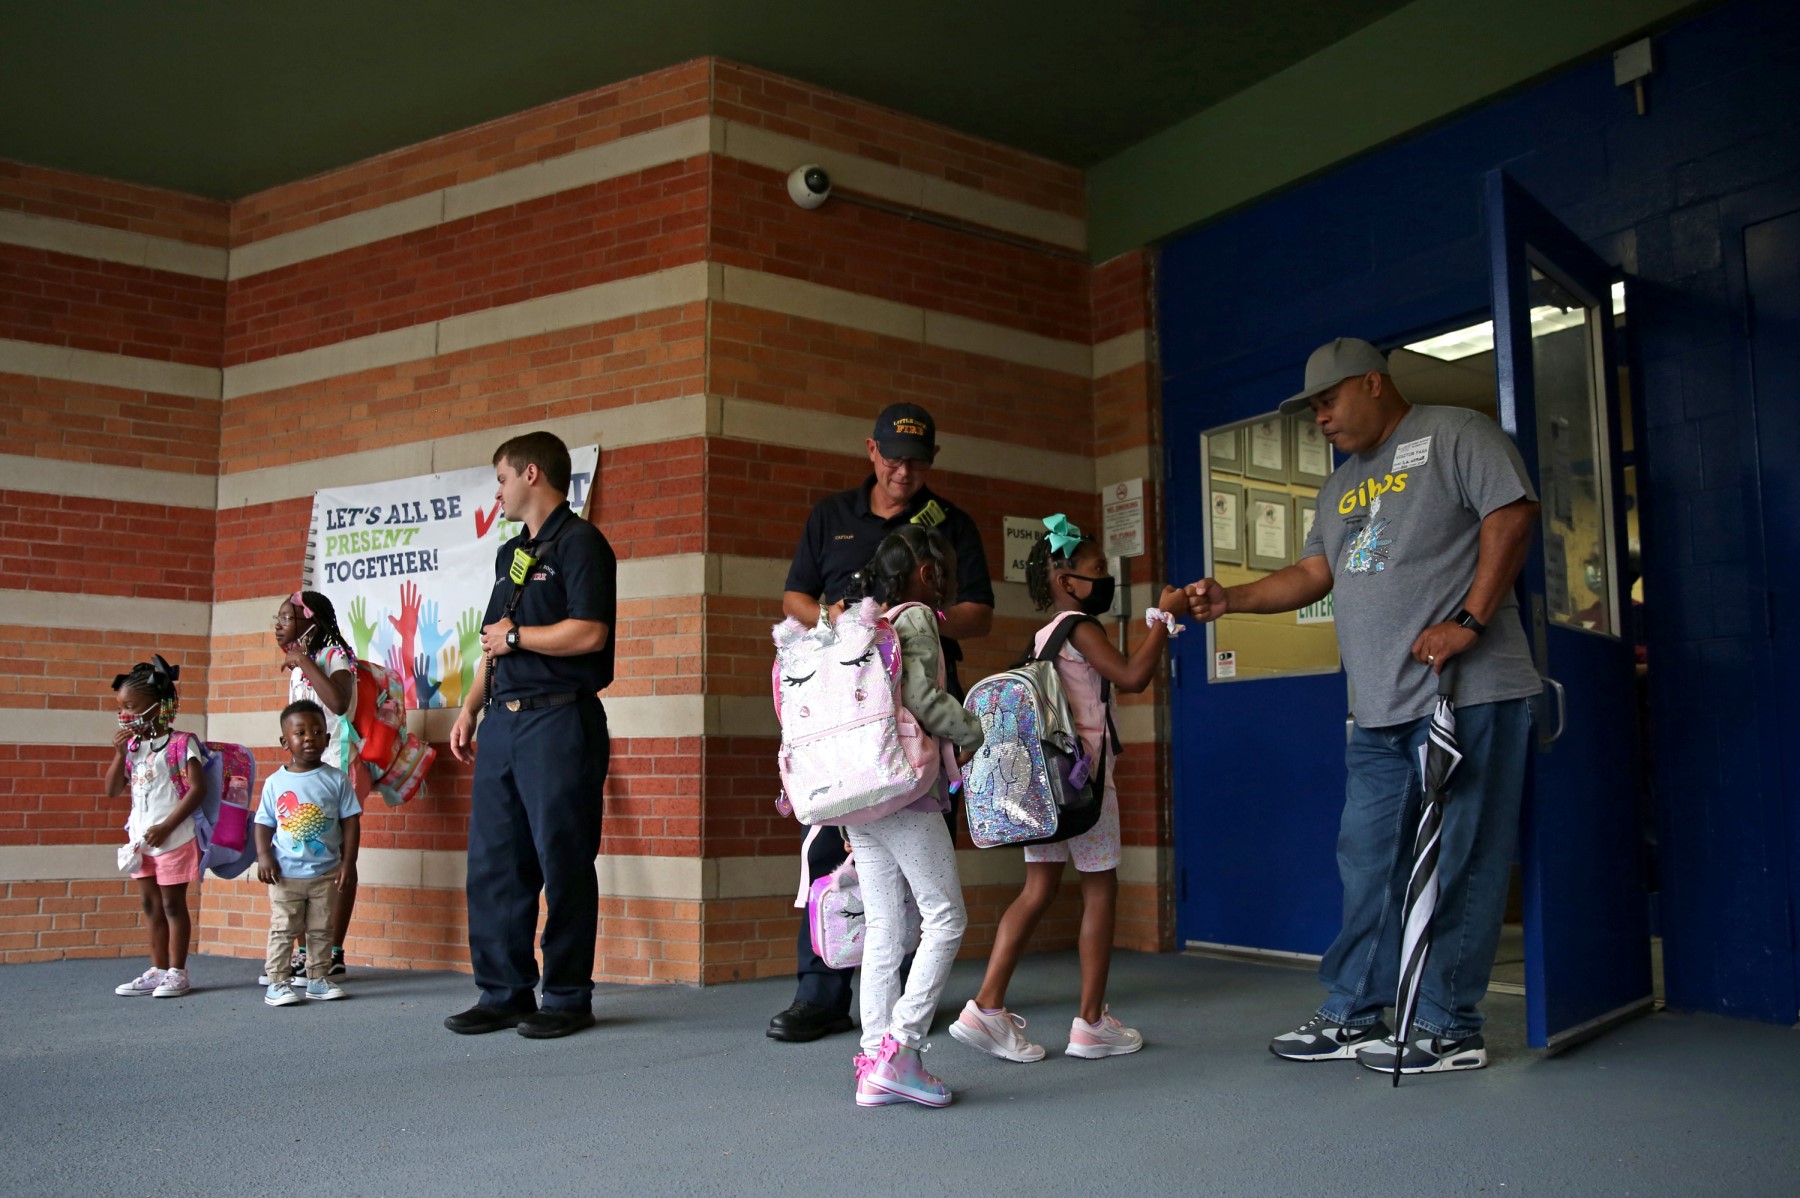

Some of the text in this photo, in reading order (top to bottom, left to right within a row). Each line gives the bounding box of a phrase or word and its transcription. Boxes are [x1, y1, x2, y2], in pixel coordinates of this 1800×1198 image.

[896, 425, 924, 436] FIRE
[326, 495, 462, 530] LET'S ALL BE
[325, 527, 420, 557] PRESENT
[1007, 528, 1032, 540] PUSH
[324, 549, 438, 583] TOGETHER!
